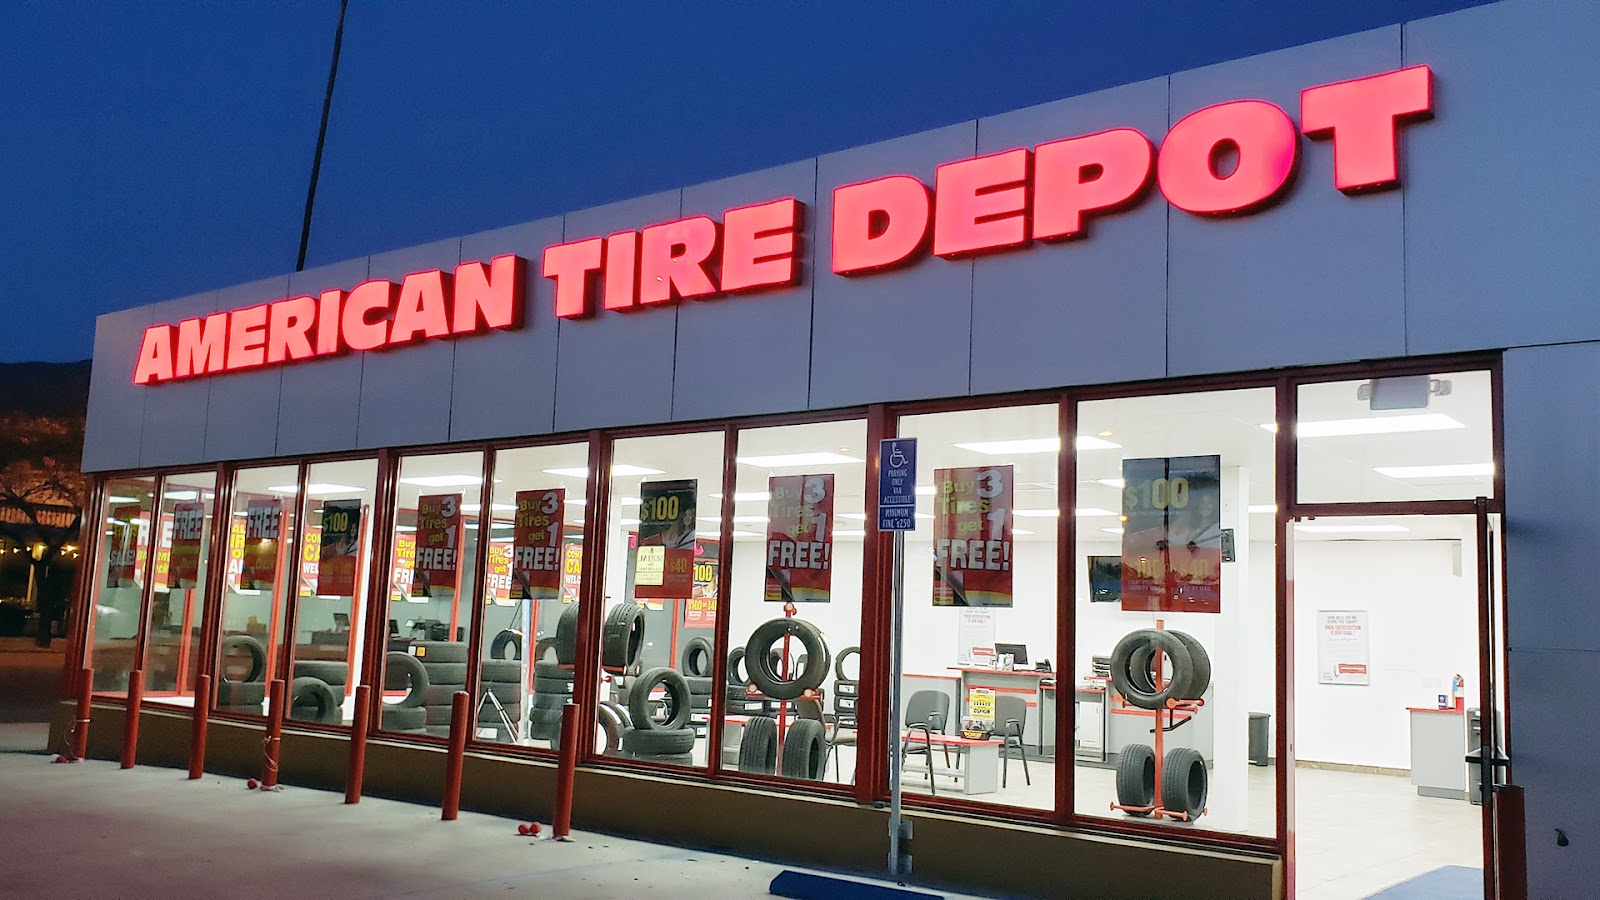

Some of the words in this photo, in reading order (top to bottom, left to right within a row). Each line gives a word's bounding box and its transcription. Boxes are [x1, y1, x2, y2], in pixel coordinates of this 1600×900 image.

[133, 254, 524, 385] AMERICAN
[543, 197, 800, 318] TIRE
[832, 64, 1434, 276] DEPOT
[888, 468, 907, 477] PARKING
[891, 478, 903, 486] ONLY
[943, 479, 975, 495] Buy
[976, 469, 1003, 498] 3
[803, 477, 826, 504] 3
[883, 495, 911, 504] ACCESSIBLE
[1124, 477, 1189, 510] $100
[421, 504, 441, 515] Buy
[440, 496, 456, 518] 3
[520, 499, 541, 512] Buy
[541, 491, 558, 515] 3
[640, 495, 679, 521] $100
[885, 508, 909, 517] MINIMUM
[938, 496, 990, 515] Tires
[173, 509, 204, 540] FREE
[247, 507, 280, 539] FREE
[322, 512, 348, 533] $100
[420, 516, 447, 530] Tires
[516, 513, 550, 528] Tires
[811, 512, 827, 542] 1
[882, 519, 894, 528] FINE
[957, 520, 984, 536] get
[986, 507, 1005, 541] 1
[398, 539, 416, 549] Buy
[429, 533, 445, 545] get
[446, 525, 456, 549] 1
[528, 529, 545, 544] get
[547, 521, 559, 547] 1
[396, 548, 415, 558] Tire
[415, 547, 457, 571] FREE!
[489, 547, 503, 557] Buy
[503, 544, 514, 558] 3
[514, 546, 560, 571] FREE!
[768, 539, 830, 570] FREE!
[936, 538, 1010, 571] FREE!
[494, 565, 506, 574] get
[566, 560, 582, 574] CA
[693, 564, 713, 581] 100
[487, 573, 511, 590] FREE
